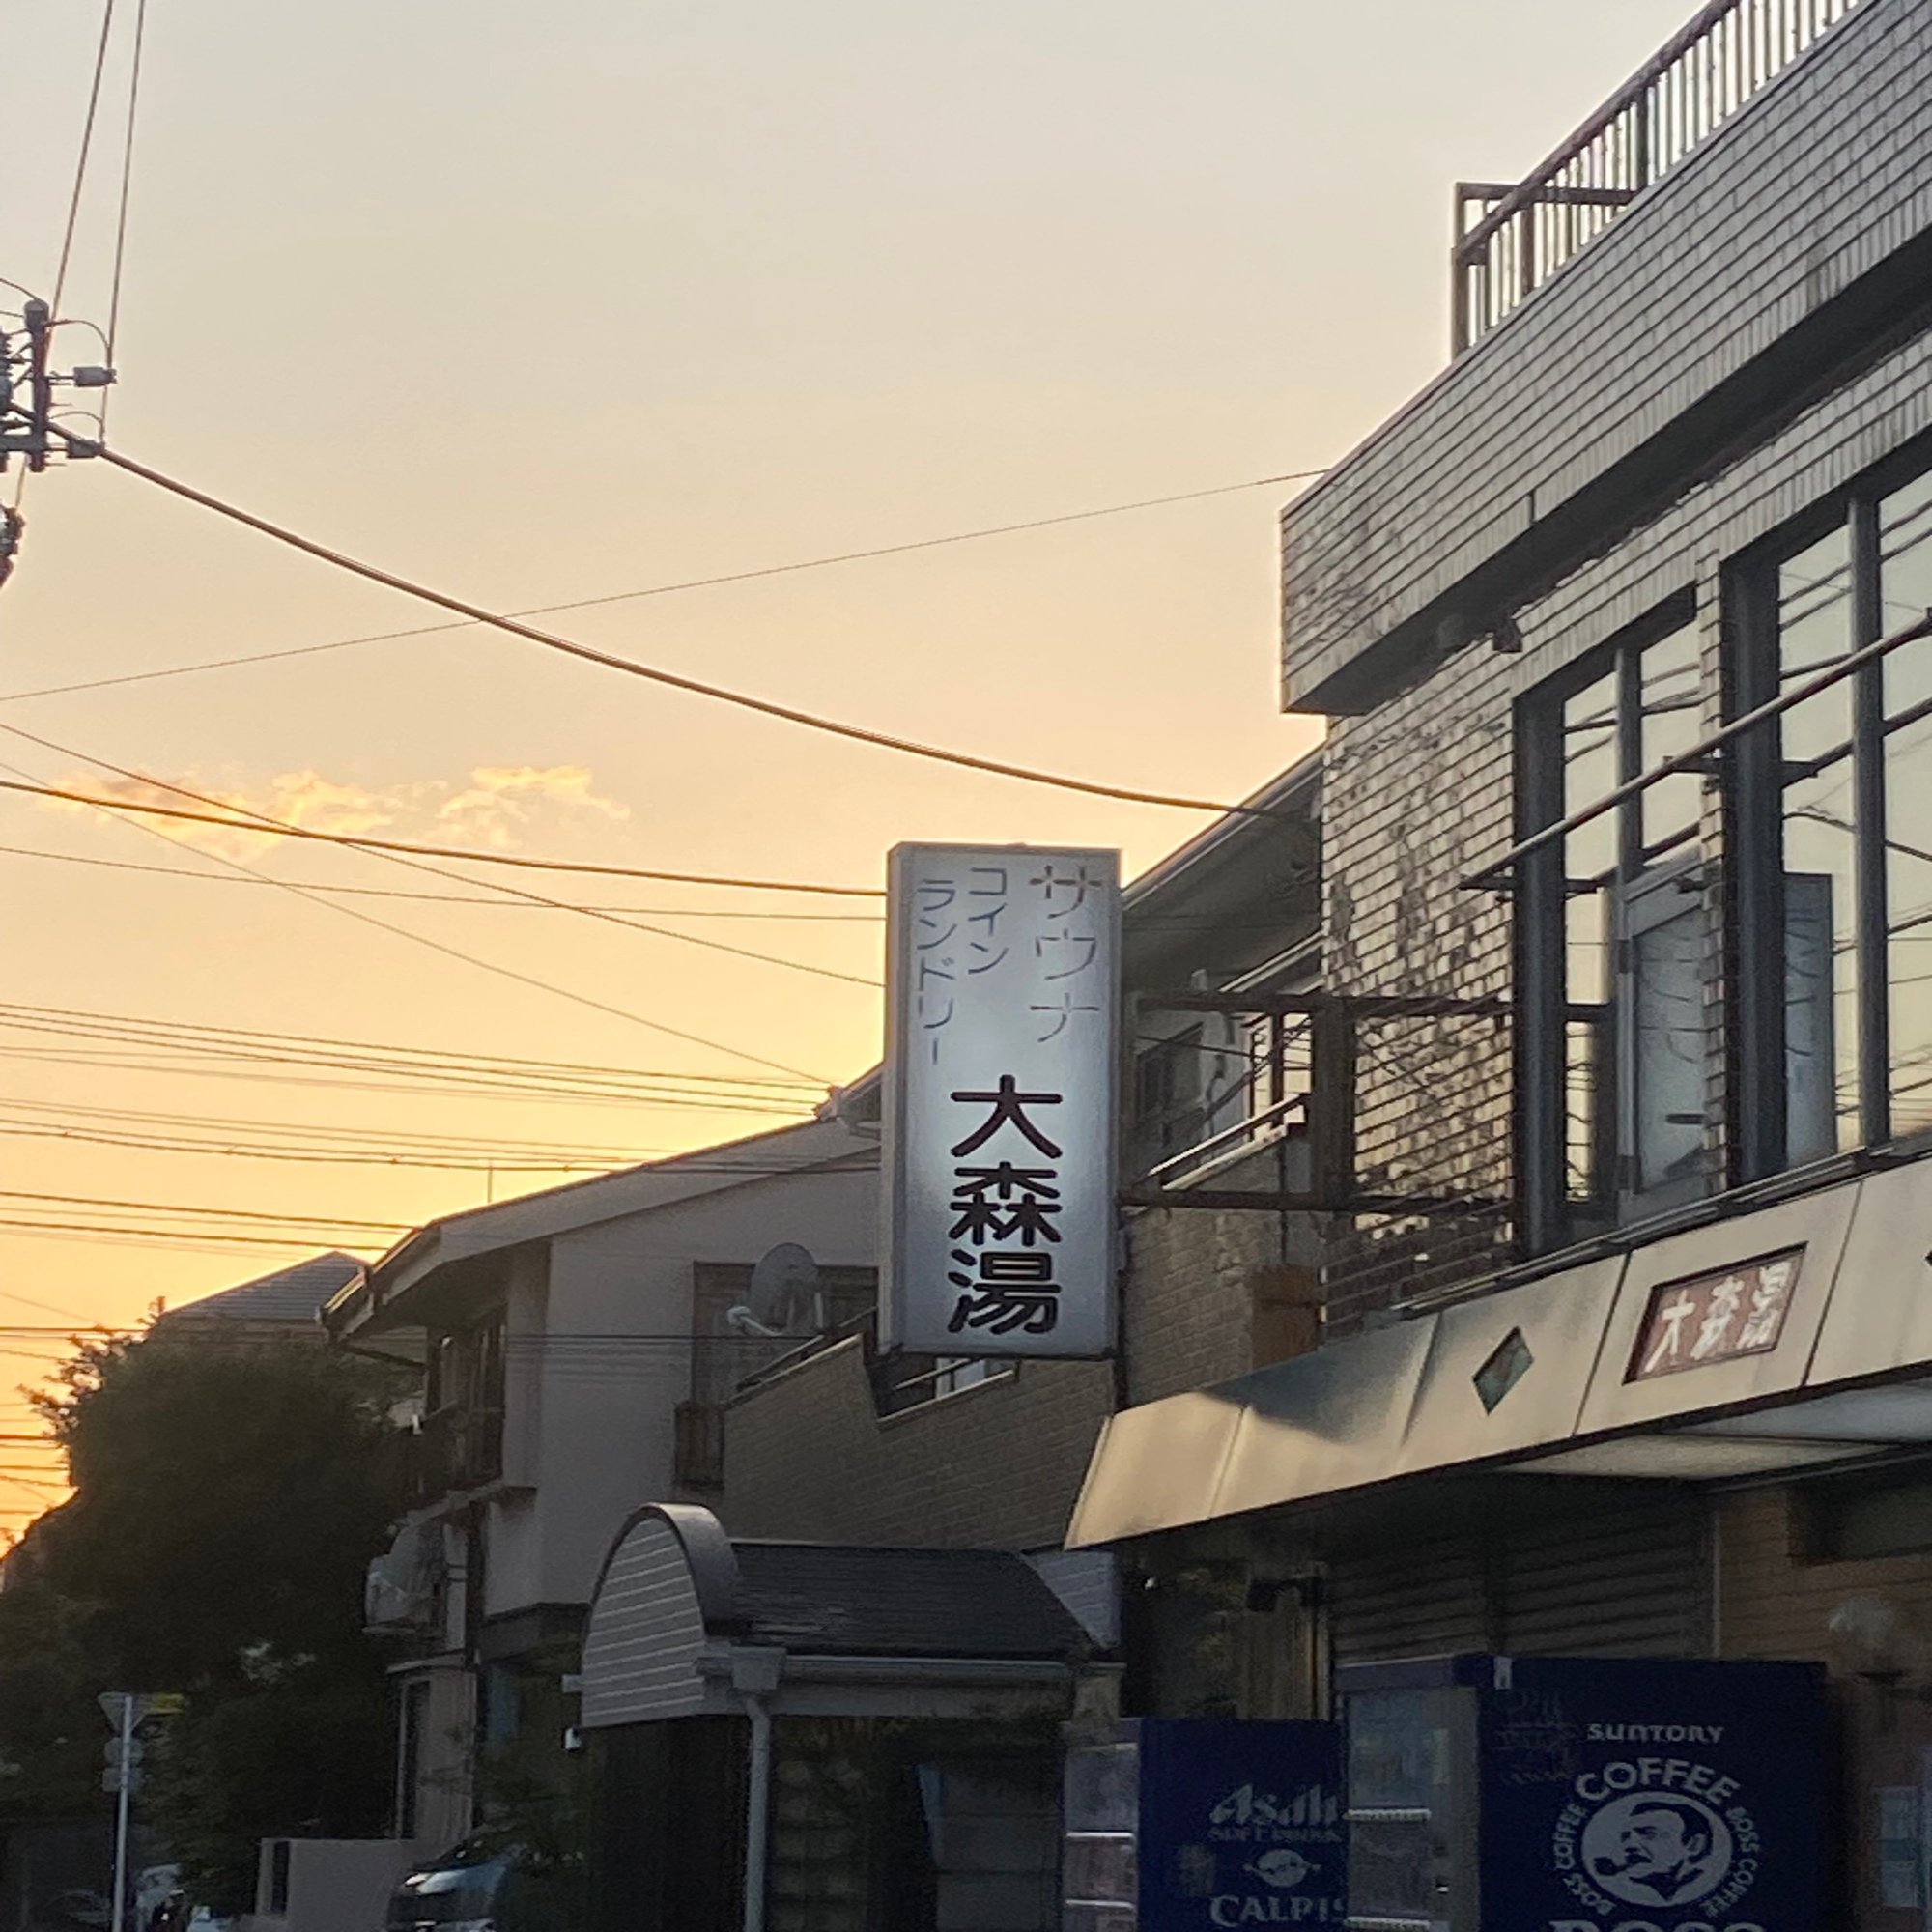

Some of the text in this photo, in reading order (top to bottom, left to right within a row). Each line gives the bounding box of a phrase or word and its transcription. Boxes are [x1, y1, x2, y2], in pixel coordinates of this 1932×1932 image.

[917, 879, 957, 1065] ランドリー
[968, 867, 1009, 975] コイン
[1029, 865, 1102, 1043] サウナ
[948, 1074, 1063, 1335] 大森湯
[1575, 1756, 1740, 1805] COFFEE
[1585, 1723, 1724, 1744] SUNTORY
